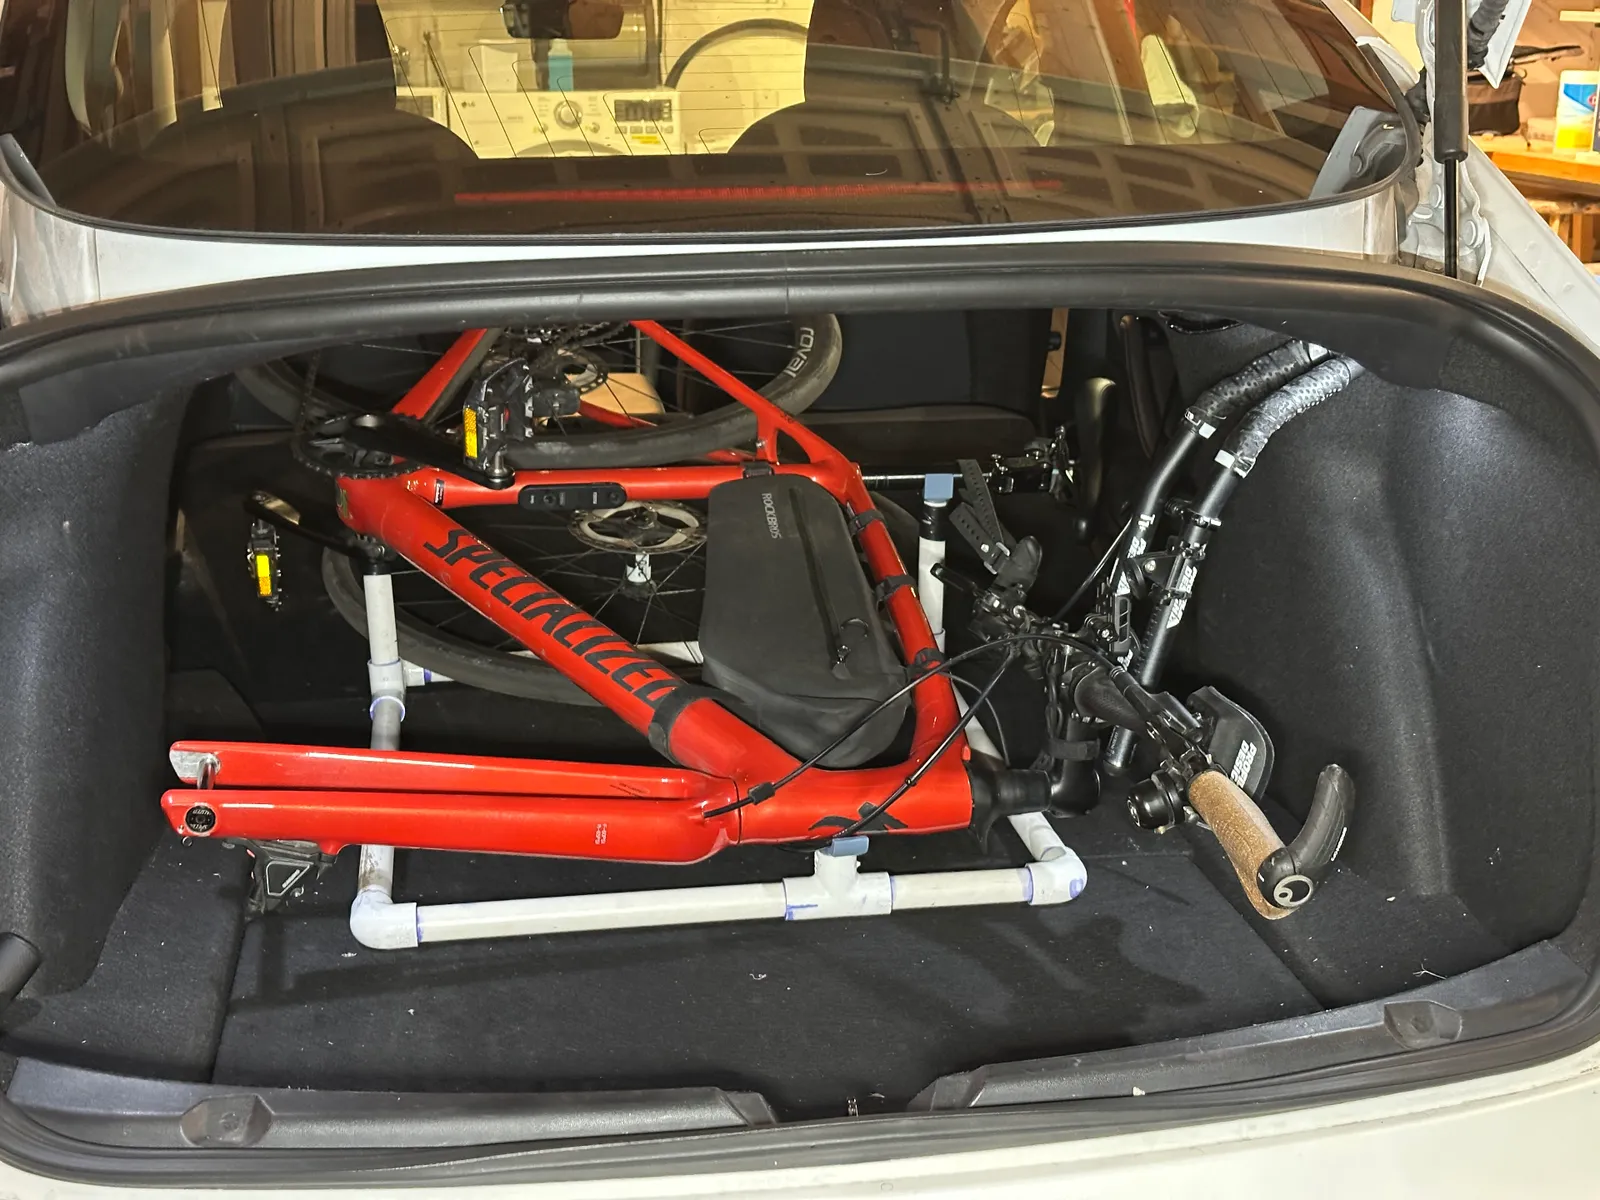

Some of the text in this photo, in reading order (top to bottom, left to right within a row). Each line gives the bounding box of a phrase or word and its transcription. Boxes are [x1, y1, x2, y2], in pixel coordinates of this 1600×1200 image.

[782, 326, 815, 378] roval
[761, 492, 783, 539] ROCKBROS
[1230, 739, 1250, 783] DESIG
[1237, 741, 1258, 788] PROFIL
